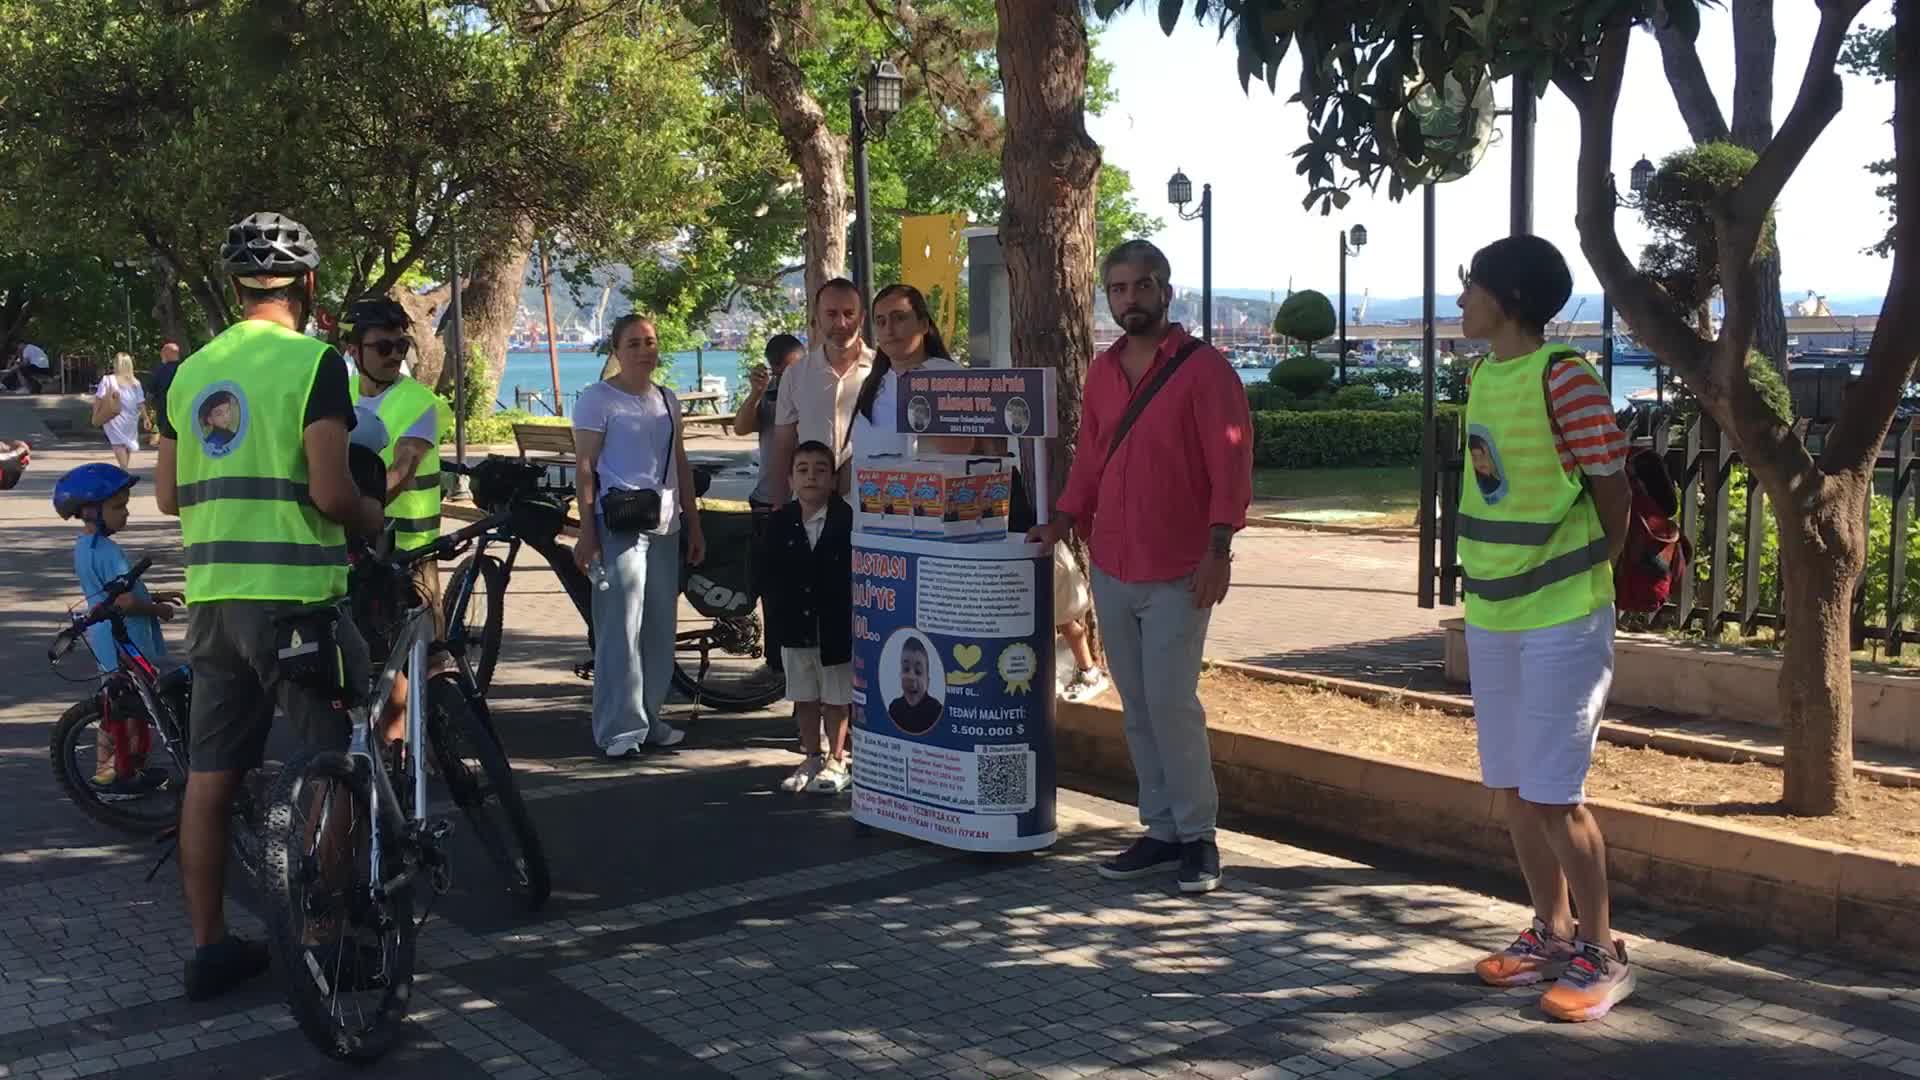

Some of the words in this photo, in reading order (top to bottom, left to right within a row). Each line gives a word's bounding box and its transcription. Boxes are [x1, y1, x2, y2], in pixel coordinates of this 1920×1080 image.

[949, 705, 978, 719] TEDAVİ
[951, 724, 1013, 737] 3.500.000
[1016, 723, 1025, 735] $
